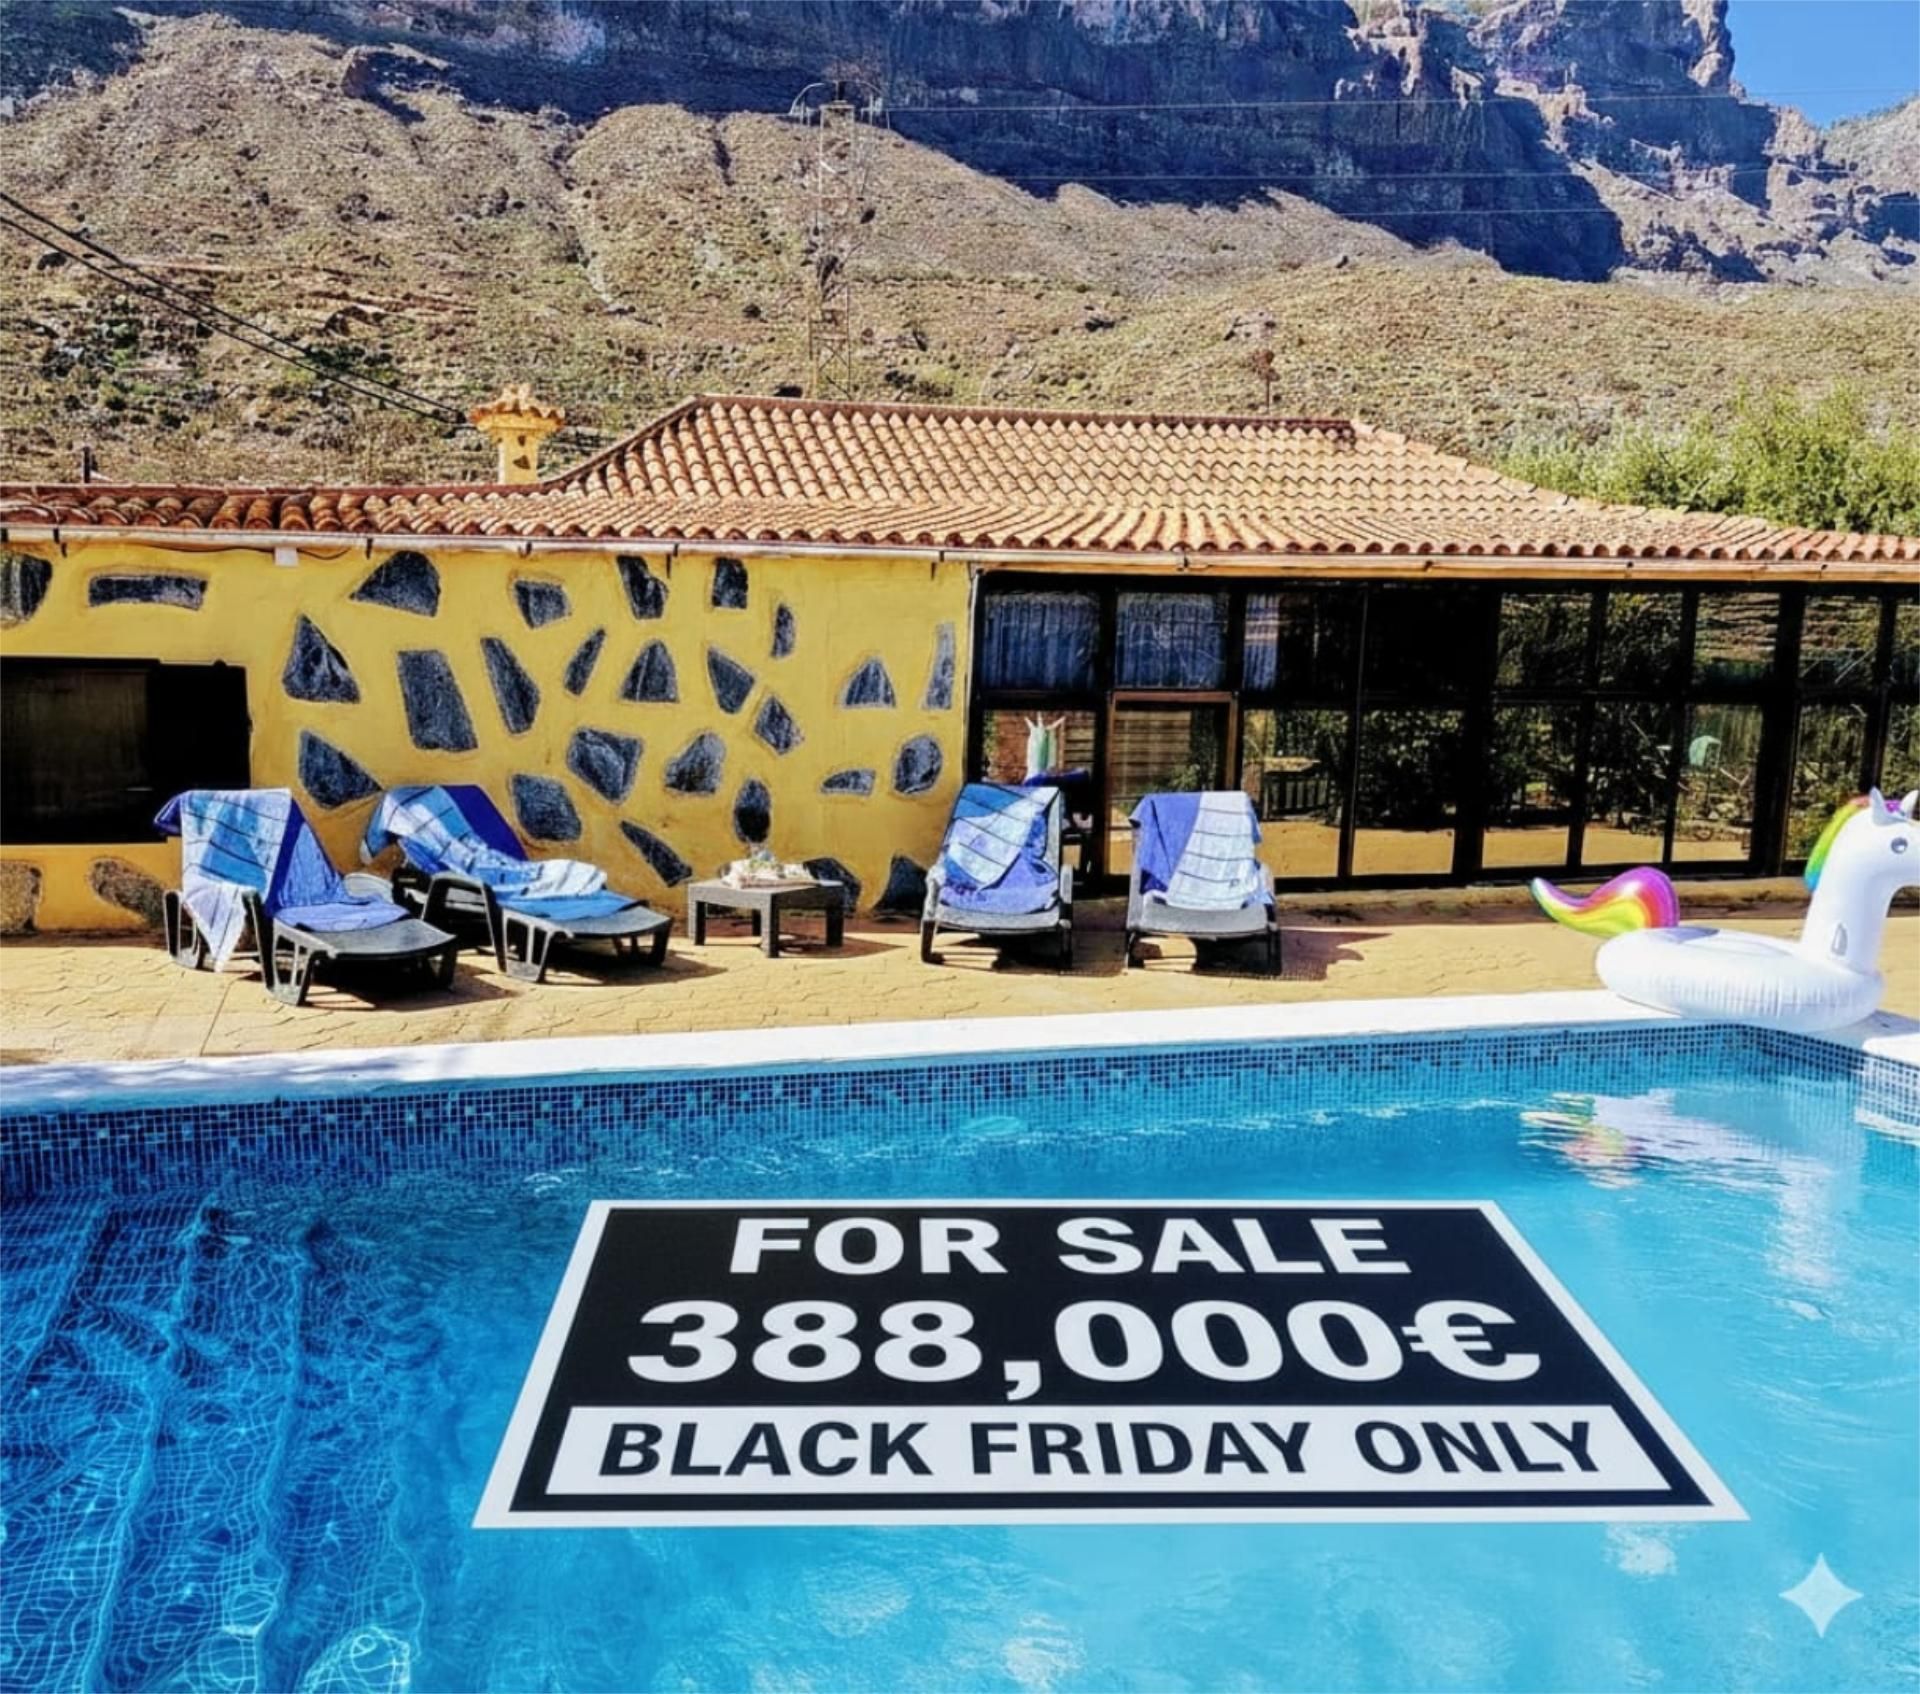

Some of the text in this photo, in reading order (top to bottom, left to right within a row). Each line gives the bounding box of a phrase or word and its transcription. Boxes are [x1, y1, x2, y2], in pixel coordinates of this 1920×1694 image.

[729, 1217, 1412, 1275] FOR SALE
[627, 1300, 1541, 1401] 388,000€
[599, 1421, 1599, 1476] BLACK FRIDAY ONLY
